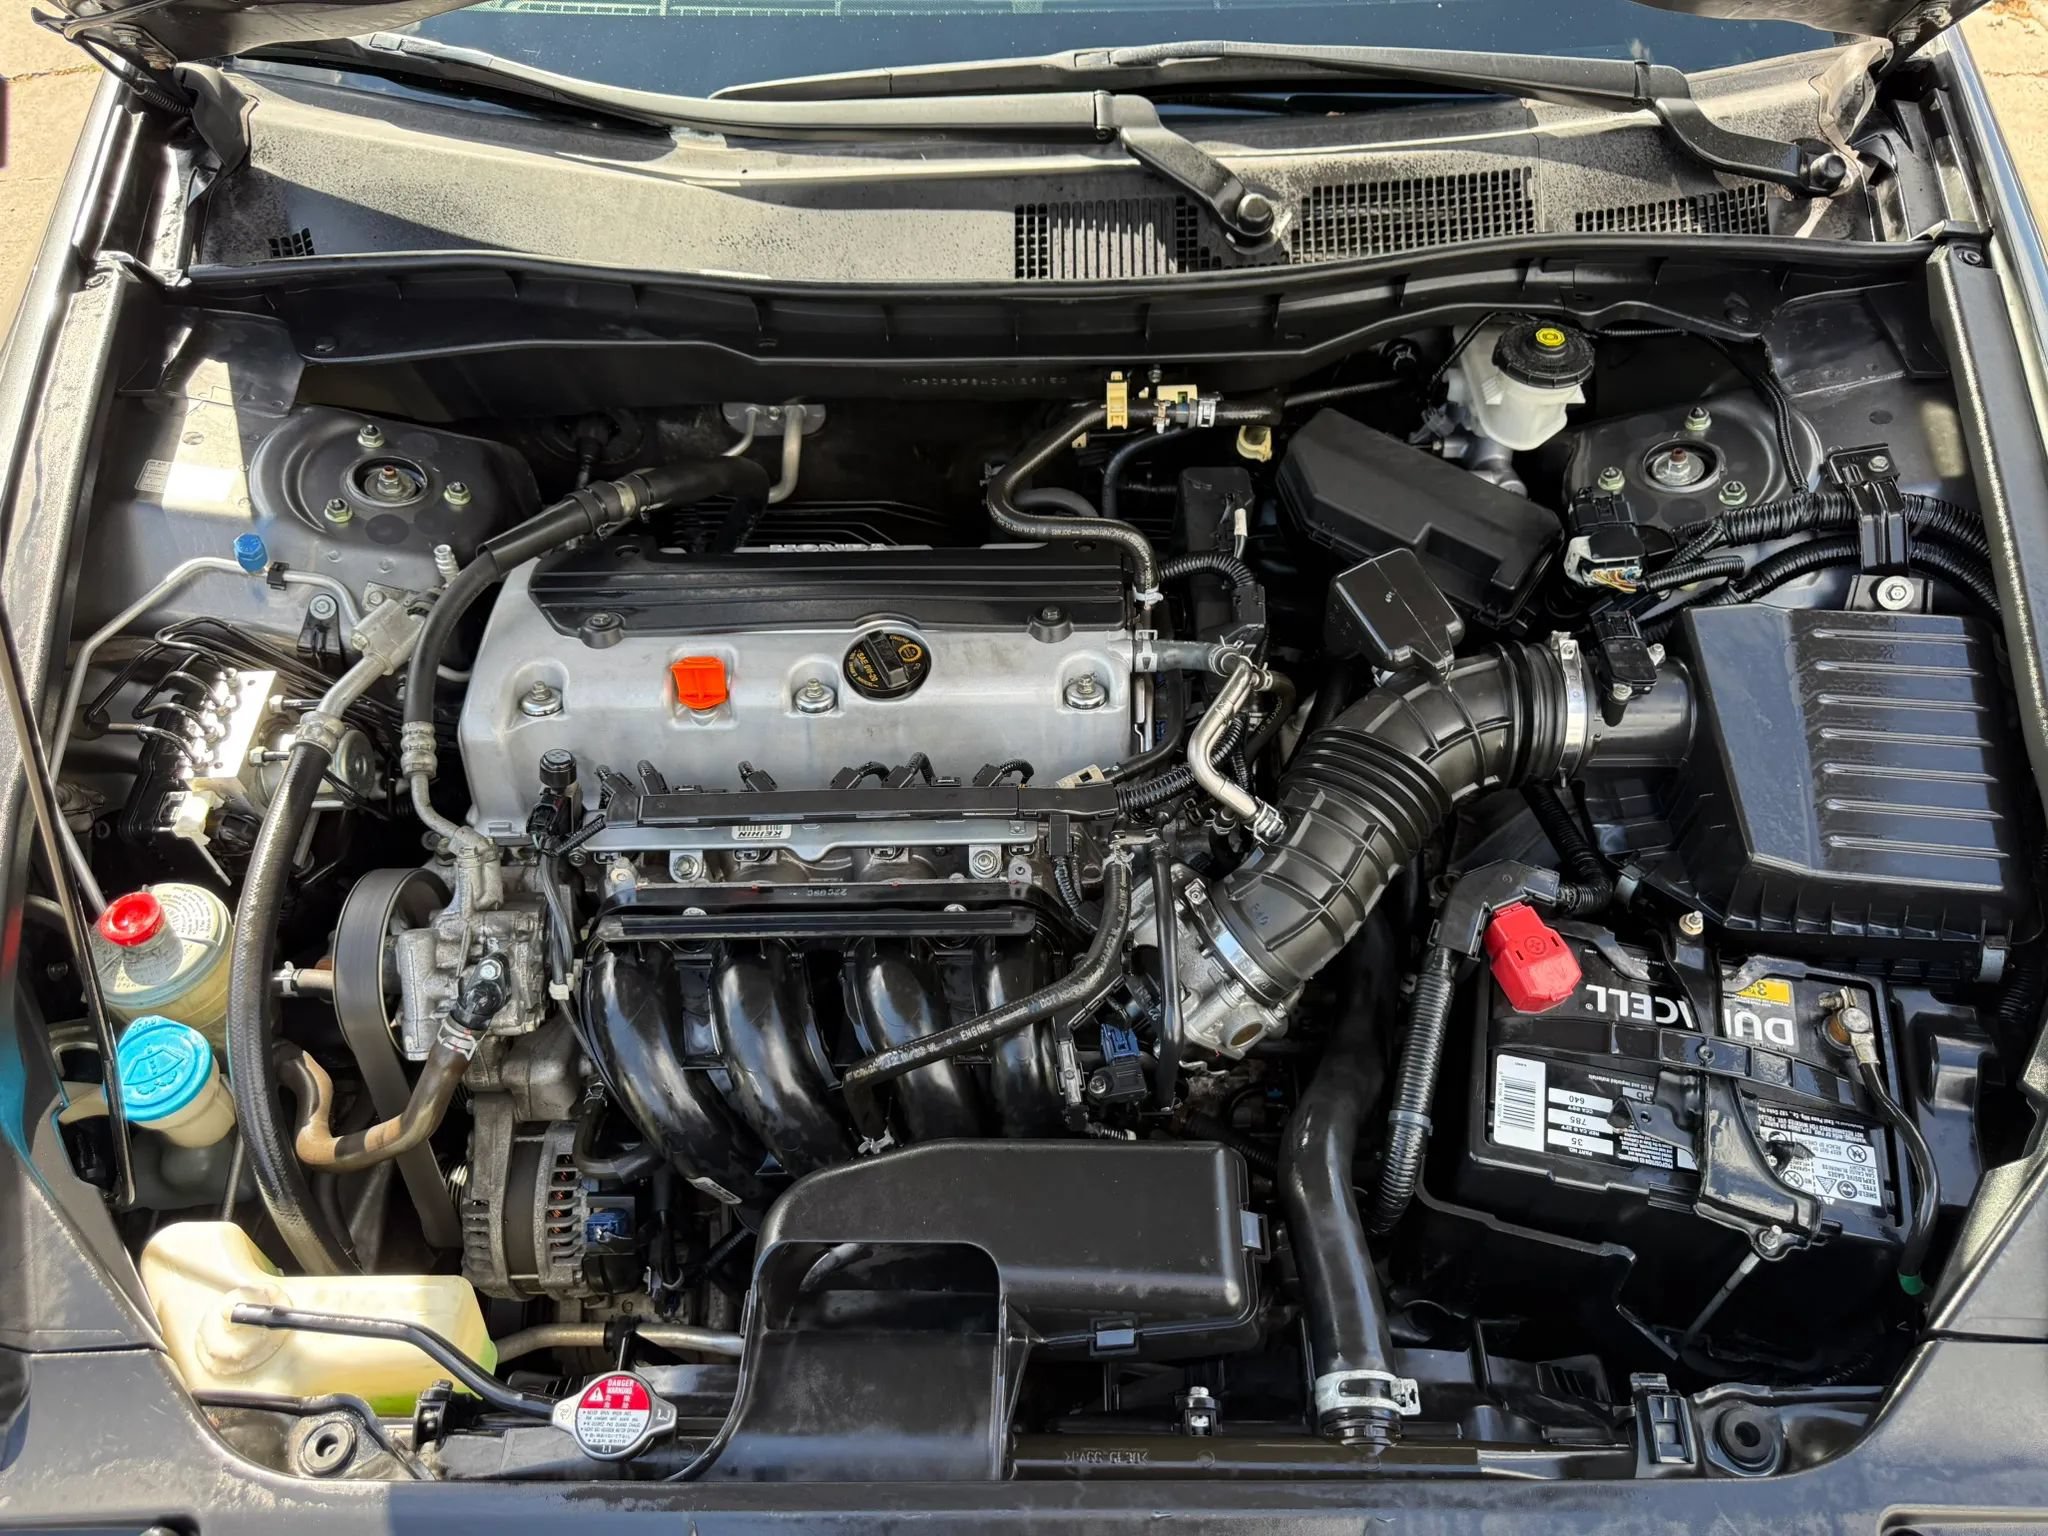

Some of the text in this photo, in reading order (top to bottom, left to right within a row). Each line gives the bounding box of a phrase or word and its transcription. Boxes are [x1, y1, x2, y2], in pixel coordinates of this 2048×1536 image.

[770, 543, 889, 553] HONDA
[1755, 981, 1768, 996] 3
[1585, 984, 1795, 1046] DUCELL
[959, 1020, 992, 1041] ENGINE
[1587, 1073, 1609, 1082] materials
[1610, 1077, 1630, 1085] imported
[1568, 1095, 1585, 1104] 640
[1569, 1115, 1587, 1125] 785
[1570, 1137, 1583, 1146] 35
[1821, 1163, 1848, 1172] BLINDNESS
[1826, 1170, 1875, 1184] EXPLOSIVE GASES
[1859, 1183, 1876, 1191] EYES.
[1857, 1190, 1877, 1198] SHIELD
[607, 1378, 634, 1386] DANGER
